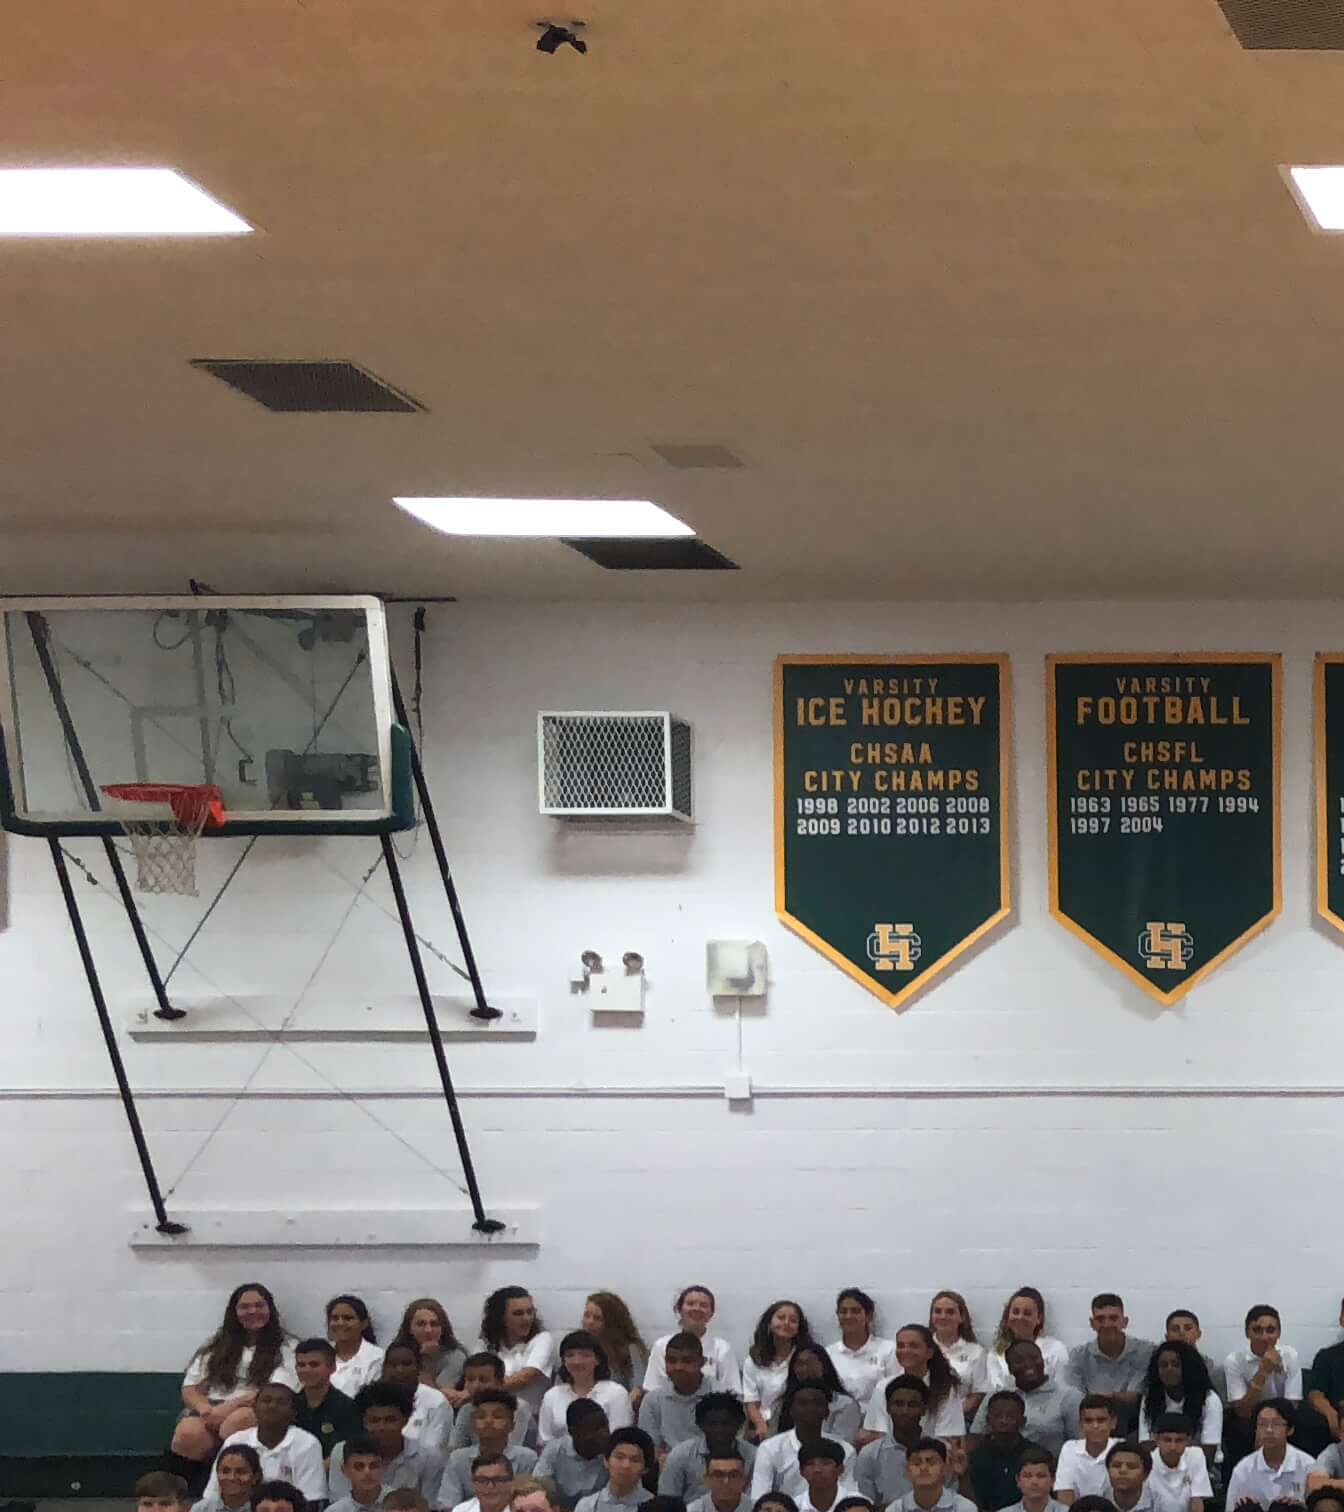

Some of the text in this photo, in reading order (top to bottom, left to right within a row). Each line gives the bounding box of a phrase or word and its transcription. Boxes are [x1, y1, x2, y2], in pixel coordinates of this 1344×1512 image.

[844, 679, 937, 695] VARSITY
[1116, 677, 1210, 694] VARSITY
[797, 697, 984, 725] ICE HOCKEY
[1078, 696, 1249, 724] FOOTBALL
[851, 743, 931, 764] CHSAA
[1124, 742, 1203, 762] CHSFL
[805, 770, 977, 791] CITY CHAMPS
[1078, 769, 1250, 790] CITY CHAMPS
[798, 797, 989, 814] 1998 2002 2006 2008
[1071, 796, 1259, 812] 1963 1965 1977 1994
[798, 818, 989, 834] 2009 2010 2012 2013
[1071, 816, 1163, 833] 1997 2004
